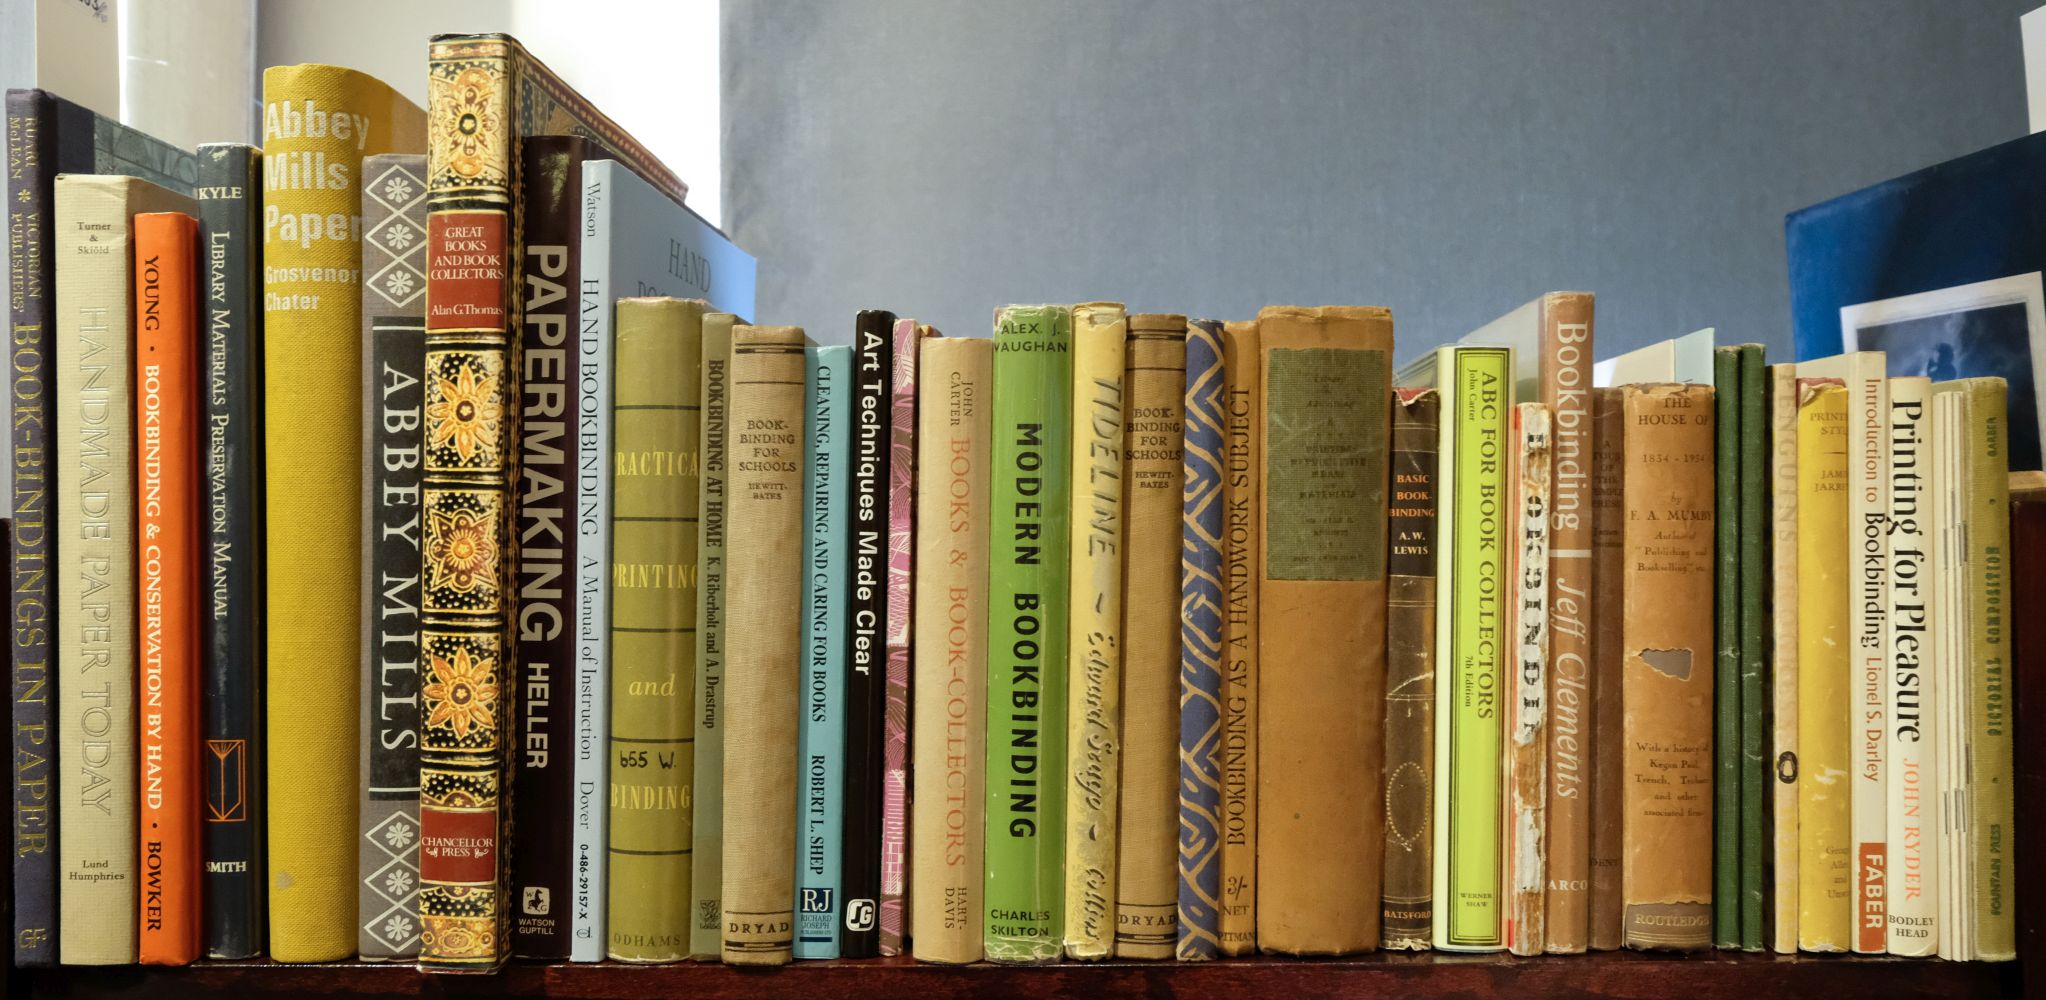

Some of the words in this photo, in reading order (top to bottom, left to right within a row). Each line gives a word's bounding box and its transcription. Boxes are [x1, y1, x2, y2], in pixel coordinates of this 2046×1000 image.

[24, 117, 38, 167] RUARI
[265, 99, 370, 150] Abbey
[10, 117, 22, 179] McLEAN
[199, 187, 242, 200] KYLE
[265, 151, 349, 192] Mills
[76, 222, 111, 232] Turner
[445, 226, 484, 238] GREAT
[586, 182, 601, 238] Watson
[26, 212, 42, 298] VICTORIAN
[90, 235, 98, 243] &
[435, 255, 463, 267] AND
[463, 255, 501, 266] BOOK
[445, 240, 487, 252] BOOKS
[211, 231, 230, 303] LIBRARY
[266, 266, 360, 284] Grosvenor
[431, 268, 504, 280] COLLECTORS
[668, 237, 712, 293] HAND
[144, 255, 160, 331] YOUNG
[266, 292, 320, 311] Chater
[582, 279, 599, 356] HAND
[1001, 323, 1043, 334] ALEX.
[1052, 324, 1060, 336] J.
[211, 309, 231, 406] MATERIALS
[863, 331, 883, 371] Art
[992, 341, 1067, 353] VAUGHAN
[950, 371, 960, 427] CARTER
[961, 381, 974, 417] JOHN
[1467, 368, 1478, 390] John
[1481, 372, 1497, 420] ABC
[79, 306, 111, 540] HANDMADE
[707, 360, 724, 472] BOOKBINDING
[747, 420, 788, 430] BOOK-
[816, 365, 831, 448] CLEANING,
[1134, 408, 1174, 419] BOOK-
[1468, 394, 1478, 421] Carter
[1551, 320, 1588, 531] Bookbinding
[1638, 414, 1687, 425] HOUSE
[1664, 397, 1691, 408] THE
[145, 365, 161, 518] BOOKBINDING
[519, 245, 568, 642] PAPERMAKING
[580, 363, 599, 537] BOOKBINDING
[739, 434, 795, 444] BINDING
[1126, 422, 1180, 432] BINDING
[1140, 436, 1167, 446] FOR
[1229, 385, 1250, 487] SUBJECT
[1865, 379, 1881, 481] Introduction
[211, 413, 230, 534] PRESERVATION
[383, 361, 420, 551] ABBEY
[739, 461, 797, 473] SCHOOLS
[753, 448, 780, 458] FOR
[857, 379, 882, 522] Techniques
[1088, 376, 1122, 557] TIDELINE
[1125, 450, 1181, 460] SCHOOLS
[1481, 428, 1497, 474] FOR
[1886, 399, 1923, 536] Printing
[13, 321, 47, 647] BOOK-BINDINGS
[707, 477, 722, 497] AT
[815, 452, 829, 533] REPAIRING
[951, 439, 970, 534] BOOKS
[1015, 423, 1043, 565] MODERN
[1397, 474, 1430, 483] BASIC
[1397, 491, 1432, 500] BOOK-
[1865, 486, 1878, 503] to
[145, 523, 161, 539] &
[707, 501, 723, 547] HOME
[1389, 508, 1434, 517] BINDING
[1480, 485, 1496, 552] BOOK
[815, 538, 828, 570] AND
[950, 549, 968, 568] &
[1394, 546, 1428, 554] LEWIS
[1399, 532, 1410, 540] A.
[1412, 532, 1426, 540] W.
[213, 542, 232, 621] MANUAL
[583, 555, 599, 568] A
[708, 556, 721, 571] K.
[857, 531, 878, 601] Made
[1228, 496, 1249, 627] HANDWORK
[1861, 512, 1885, 649] Bookbinding
[1894, 547, 1924, 597] for
[80, 555, 111, 675] PAPER
[582, 575, 599, 642] Manual
[706, 573, 720, 629] Riberholt
[814, 573, 828, 632] CARING
[1550, 578, 1586, 644] Jeff
[1986, 546, 2001, 645] COMPOSITION
[145, 545, 163, 707] CONSERVATION
[706, 632, 717, 654] and
[855, 610, 876, 676] Clear
[1236, 634, 1248, 649] A
[1478, 561, 1495, 719] COLLECTORS
[381, 571, 419, 750] MILLS
[582, 646, 599, 664] of
[706, 658, 718, 672] A.
[813, 636, 827, 667] FOR
[1231, 659, 1248, 689] AS
[1895, 601, 1926, 743] Pleasure
[15, 658, 49, 706] IN
[629, 673, 677, 697] and
[703, 675, 719, 729] Drastrup
[812, 670, 827, 723] BOOKS
[1087, 631, 1116, 730] Edward
[1465, 672, 1474, 707] Edition
[1866, 657, 1882, 703] Lionel
[1986, 657, 2003, 736] PICTORIAL
[148, 714, 162, 740] BY
[526, 663, 550, 769] HELLER
[580, 668, 597, 760] Instruction
[947, 587, 969, 867] BOOK-COLLECTORS
[1009, 593, 1040, 838] BOOKBINDING
[1555, 652, 1587, 800] Clements
[1866, 706, 1882, 724] S.
[81, 682, 112, 816] TODAY
[1227, 695, 1247, 846] BOOKBINDING
[1864, 728, 1883, 782] Darley
[16, 720, 49, 858] PAPER
[148, 745, 163, 810] HAND
[610, 783, 691, 809] BINDING
[811, 755, 825, 815] ROBERT
[1903, 758, 1920, 818] JOHN
[579, 781, 594, 830] Dover
[810, 820, 824, 833] L.
[82, 860, 109, 869] Lund
[422, 836, 494, 848] CHANCELLOR
[441, 847, 471, 858] PRESS
[810, 836, 824, 875] SHEP
[1904, 826, 1921, 902] RYDER
[69, 872, 125, 882] Humphries
[147, 841, 162, 931] BOWKER
[578, 844, 589, 920] 0-486-29157-X
[1548, 879, 1588, 891] ARCO
[1865, 854, 1885, 928] FABER
[518, 919, 555, 927] WATSON
[802, 889, 831, 912] RJ
[945, 887, 955, 929] DAVIS
[957, 887, 967, 930] HART-
[991, 909, 1050, 921] CHARLES
[1084, 868, 1106, 940] Collins
[1118, 914, 1177, 925] DRYAD
[1384, 910, 1431, 919] BATSFORD
[1888, 915, 1935, 926] BODLEY
[519, 927, 555, 935] GUPTILL
[729, 923, 790, 934] DRYAD
[991, 925, 1049, 936] SKILTON
[1896, 928, 1929, 938] HEAD
